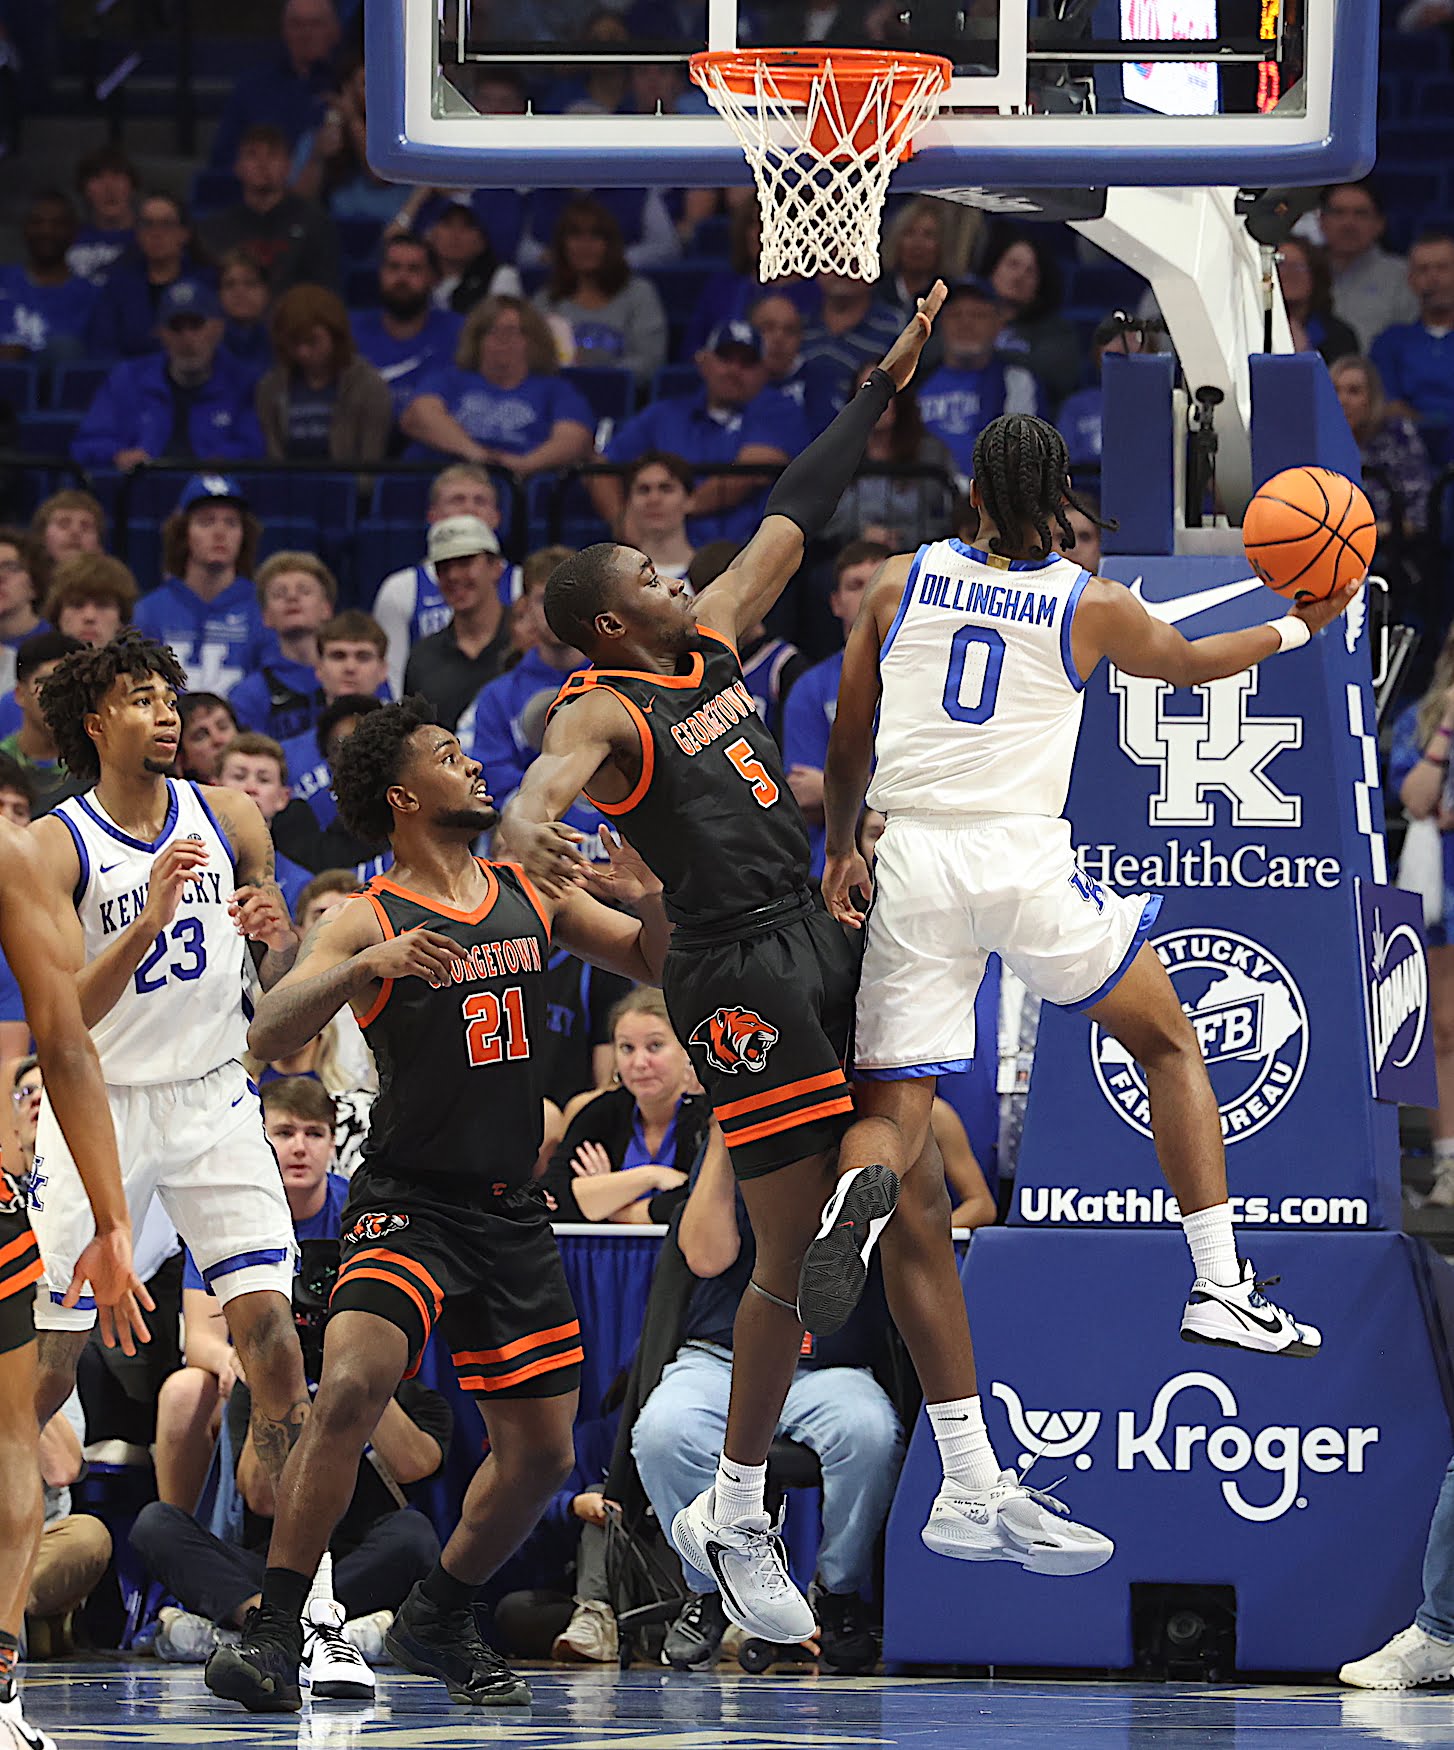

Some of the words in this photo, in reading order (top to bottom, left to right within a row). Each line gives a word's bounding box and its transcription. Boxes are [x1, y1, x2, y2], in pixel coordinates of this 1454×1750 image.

[919, 573, 1057, 628] DILLINGHAM
[942, 624, 1006, 725] 0
[724, 737, 779, 809] 5
[1109, 662, 1302, 828] UK
[1076, 838, 1341, 888] HealthCare
[99, 872, 222, 935] KENCKY
[134, 916, 207, 994] 23
[428, 937, 541, 989] ORGETOWN
[1155, 937, 1273, 979] NTUCKY
[462, 987, 529, 1067] 21
[1193, 1006, 1253, 1057] FB
[1371, 951, 1421, 1073] LIBMAN
[1109, 1070, 1152, 1125] FAR
[1219, 1060, 1294, 1136] UREAU
[1020, 1187, 1368, 1225] UKathlecs.com
[1117, 1371, 1379, 1522] Kroger
